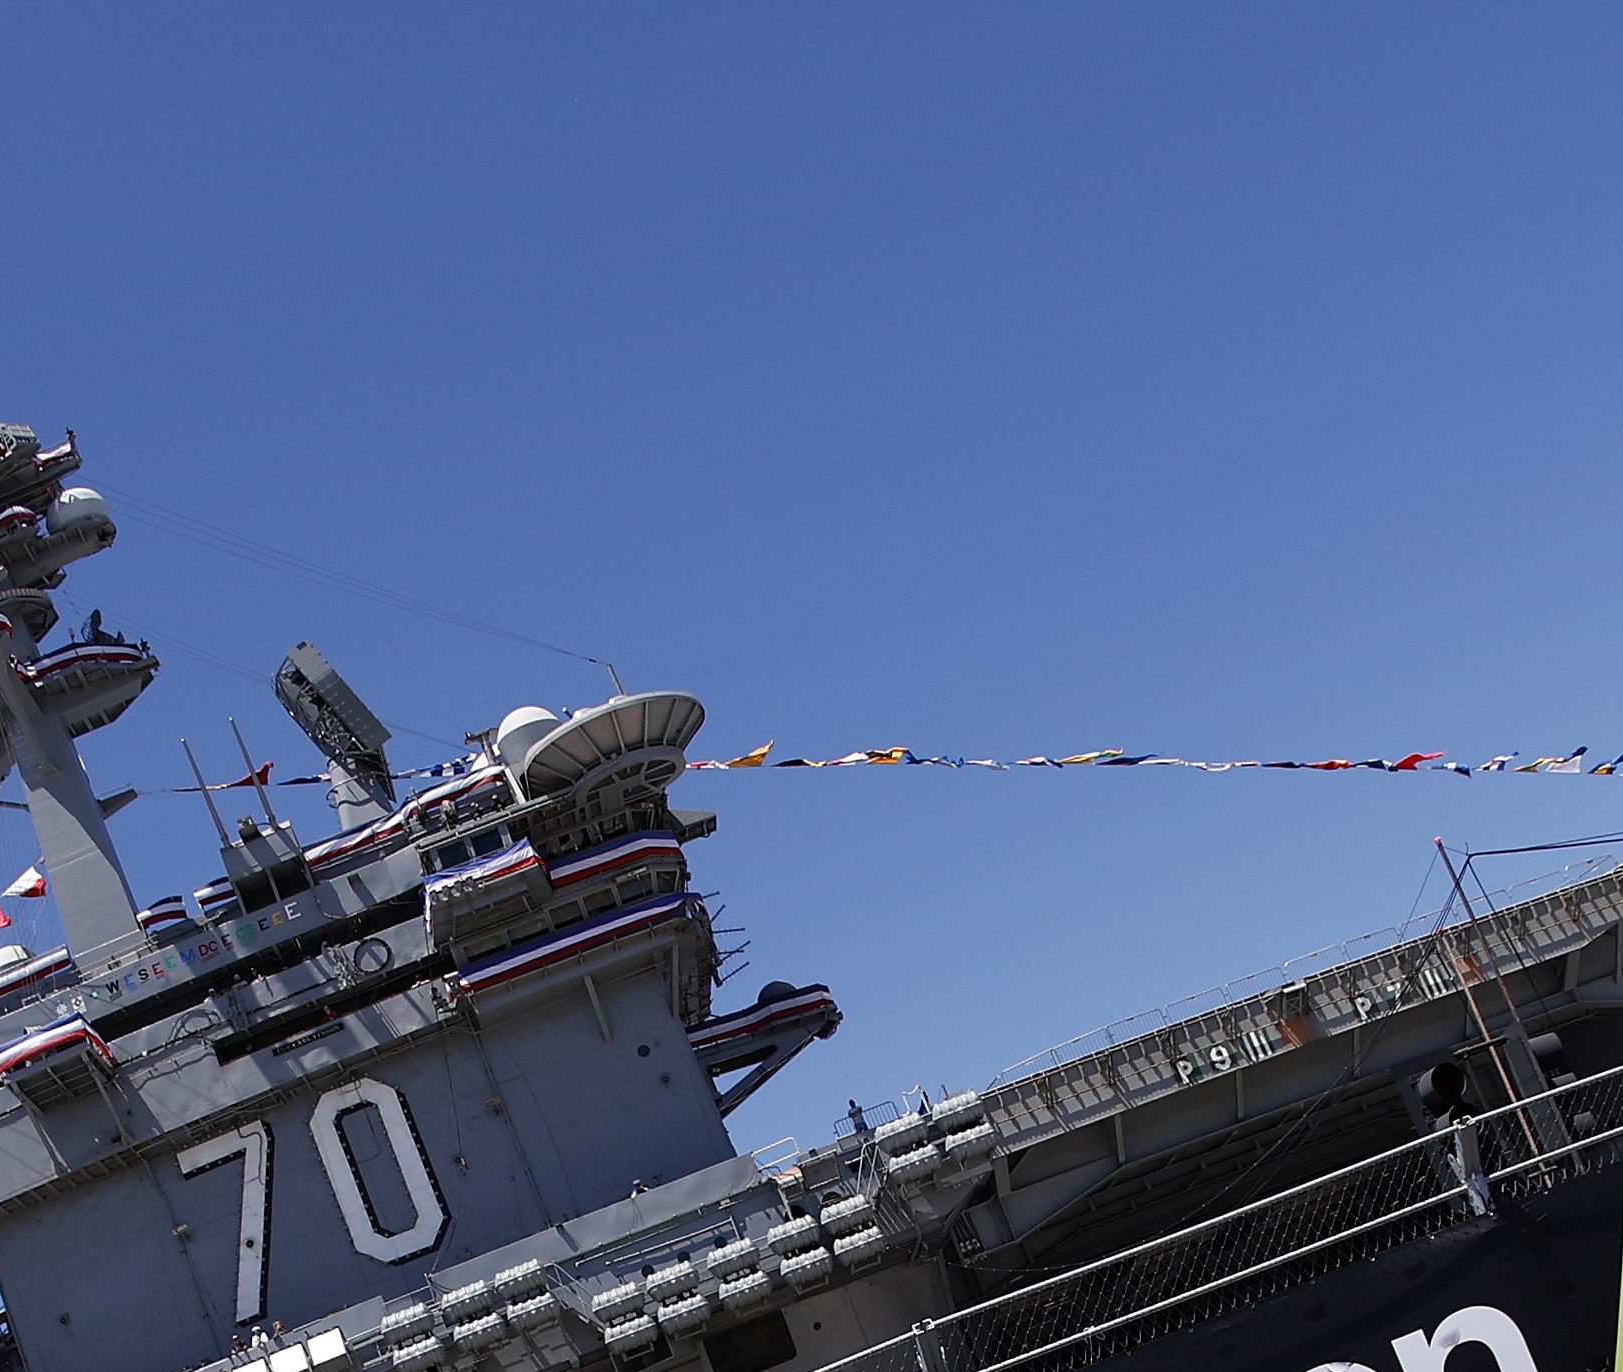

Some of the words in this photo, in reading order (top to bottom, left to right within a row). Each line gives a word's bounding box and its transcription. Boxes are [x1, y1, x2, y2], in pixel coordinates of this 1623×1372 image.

[105, 979, 121, 996] W
[138, 968, 149, 982] S
[151, 962, 163, 976] E
[258, 918, 270, 932] E
[284, 901, 302, 922] E
[1209, 1045, 1231, 1070] 9
[177, 1077, 451, 1326] 70
